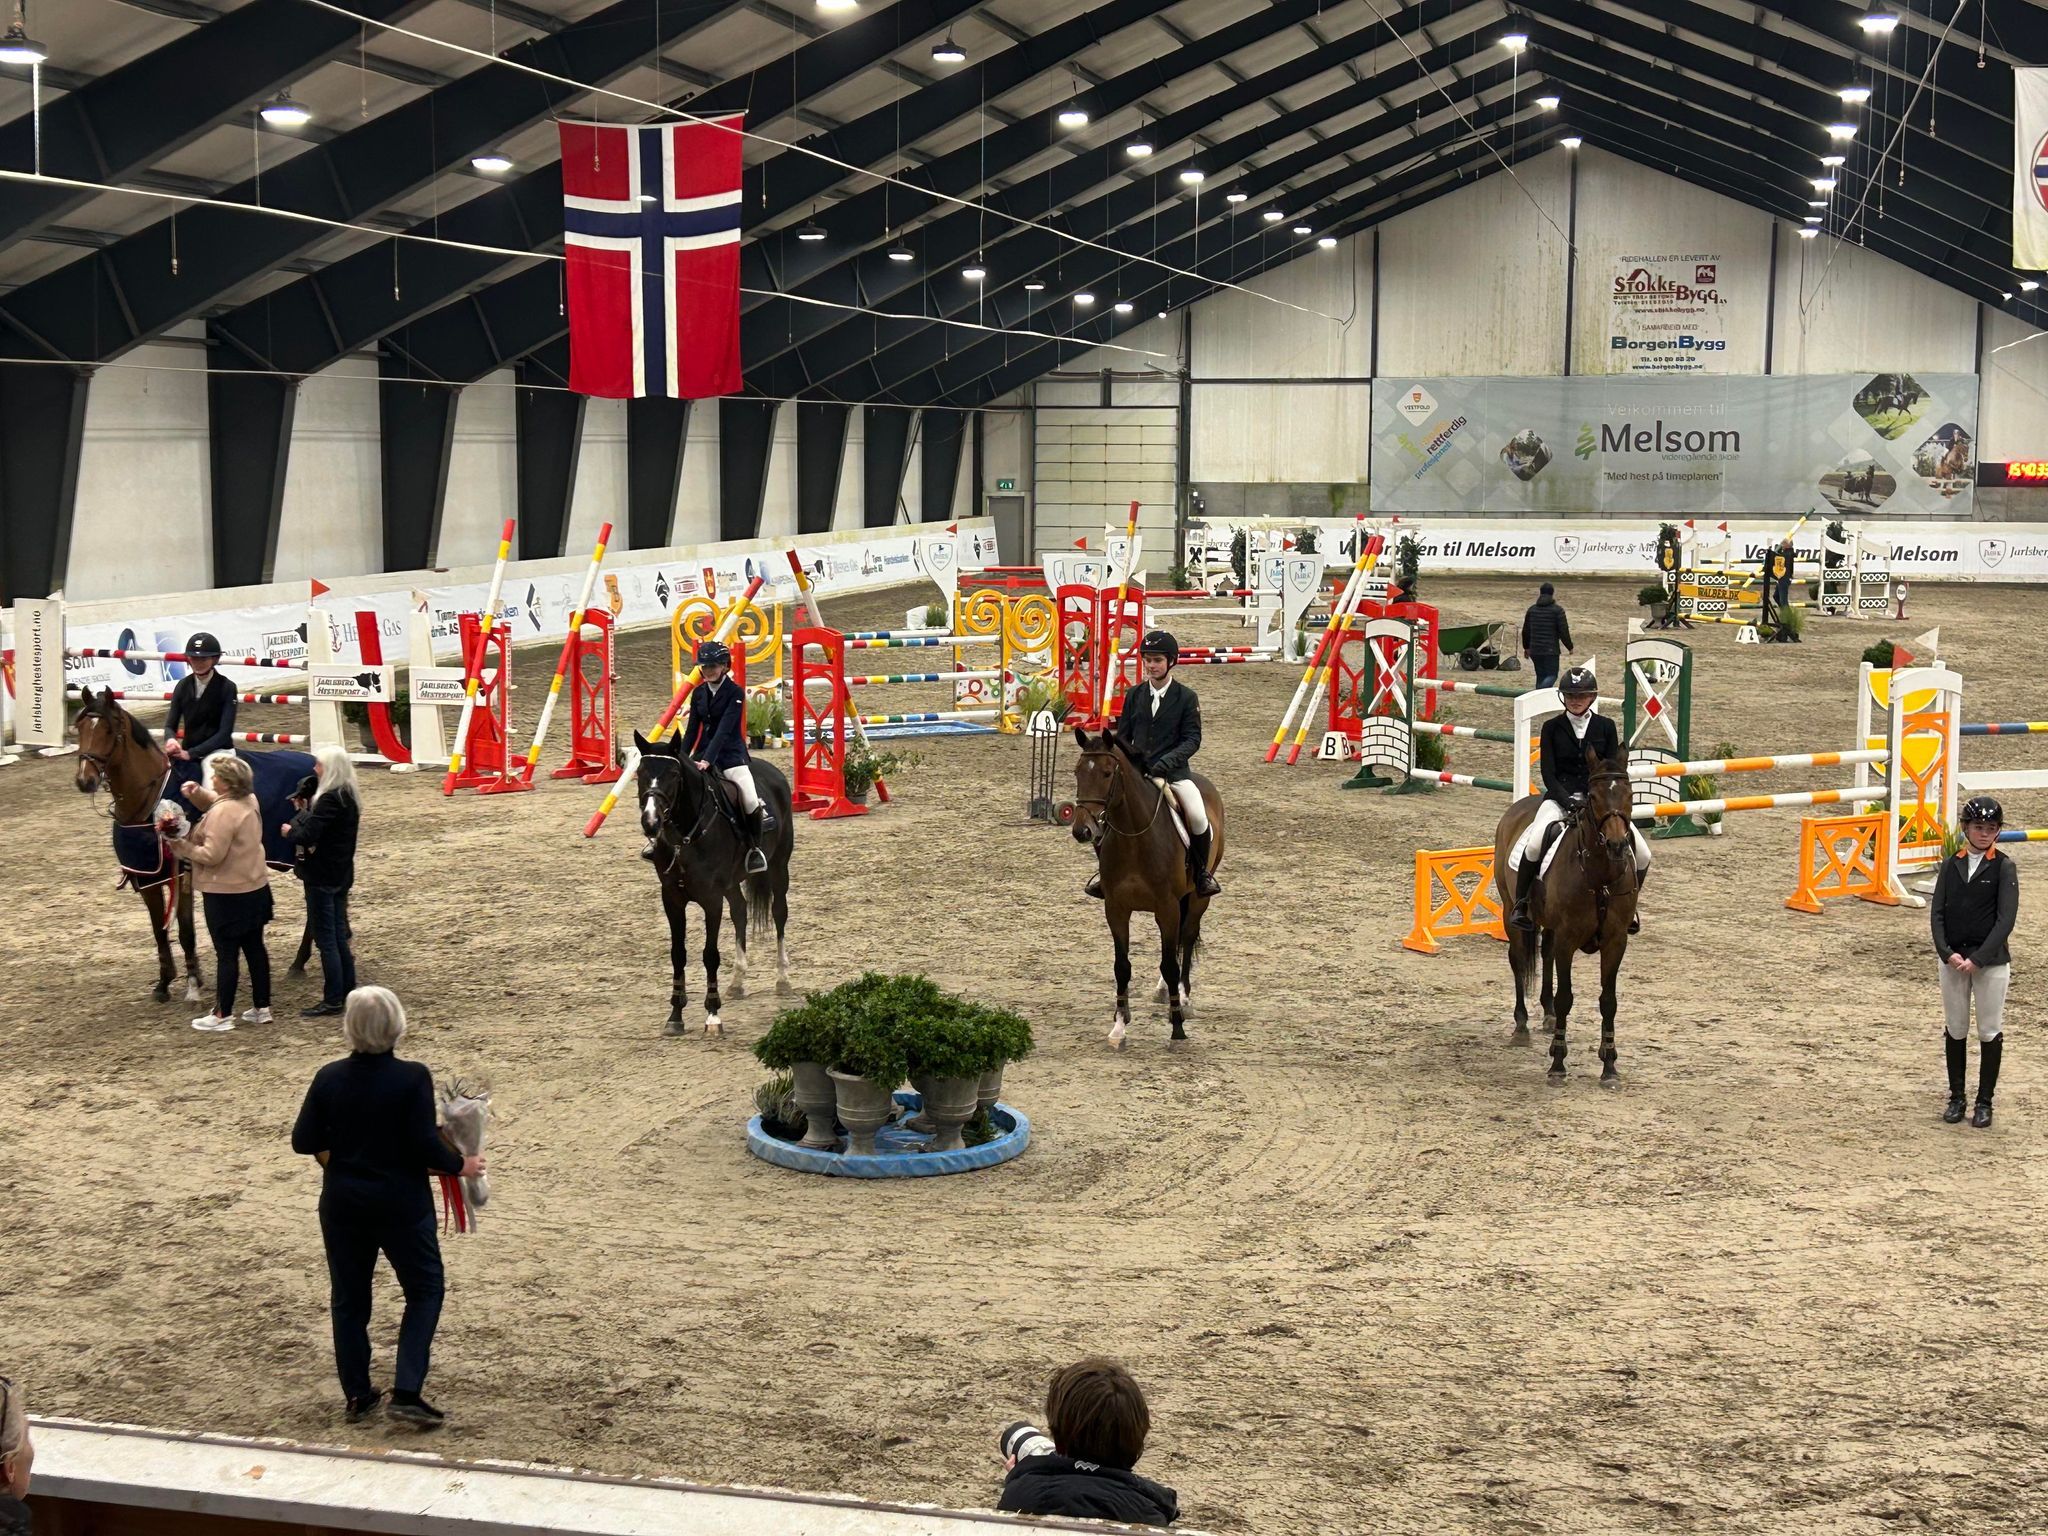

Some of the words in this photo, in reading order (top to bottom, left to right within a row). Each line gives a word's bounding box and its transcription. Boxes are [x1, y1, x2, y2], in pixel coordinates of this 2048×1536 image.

[1681, 254, 1709, 262] LEVERT
[1641, 323, 1681, 331] SAMARBEID
[1681, 322, 1698, 331] MED
[1611, 335, 1726, 351] BorgenBygg
[1709, 403, 1726, 417] til
[1426, 415, 1468, 455] rettferdig
[1601, 420, 1741, 453] Melsom
[1629, 471, 1650, 481] hest
[1651, 471, 1664, 482] på
[1443, 541, 1462, 557] til
[1466, 541, 1537, 558] Melsom
[1582, 541, 1625, 554] Jarlsberg
[2009, 546, 2048, 558] Jarlsber
[1045, 716, 1051, 730] 8
[1324, 736, 1336, 756] B
[1341, 736, 1350, 756] B
